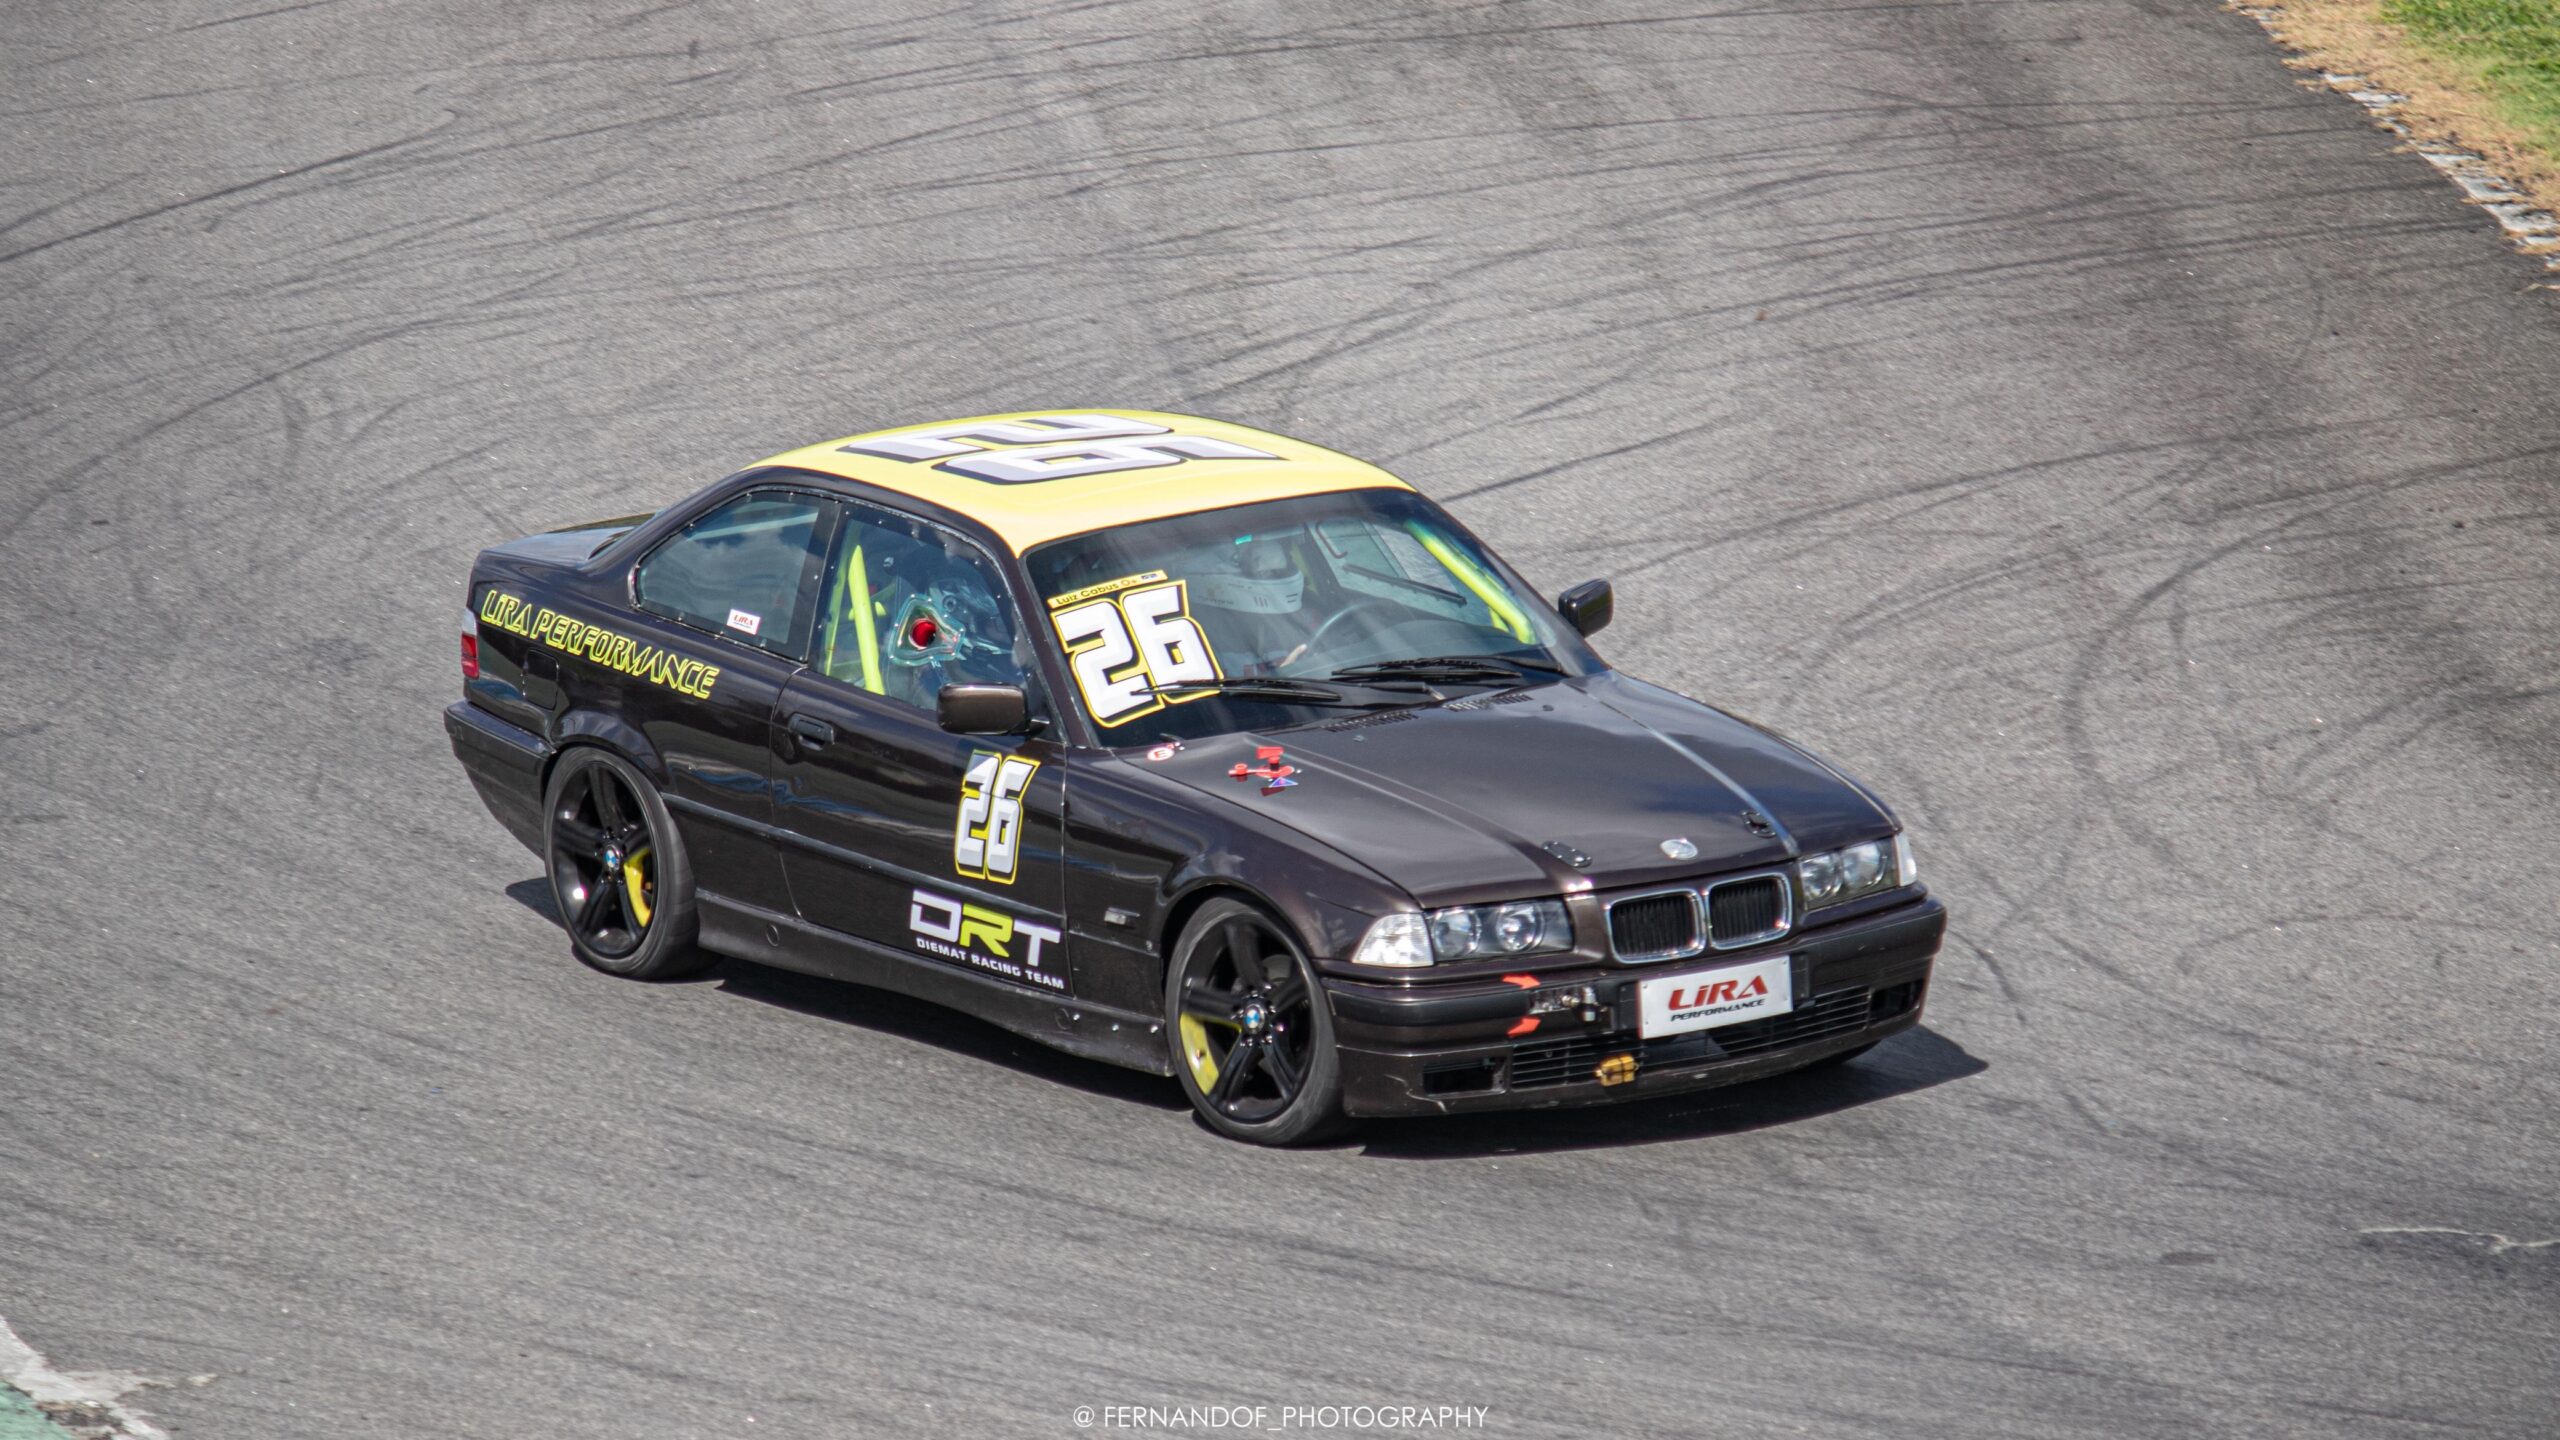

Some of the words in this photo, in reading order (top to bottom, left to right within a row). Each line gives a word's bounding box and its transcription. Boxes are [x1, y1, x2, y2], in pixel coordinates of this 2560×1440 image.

[836, 414, 1289, 486] 26
[1055, 594, 1078, 605] Luiz
[530, 608, 720, 700] PERFORMANCE
[1051, 580, 1224, 728] 26
[955, 749, 1041, 885] 26
[909, 889, 1062, 967] DRT
[916, 938, 967, 960] DIEMAT
[970, 953, 1022, 977] RACING
[1024, 969, 1065, 990] TEAM
[1670, 998, 1766, 1022] PERFORMANCE
